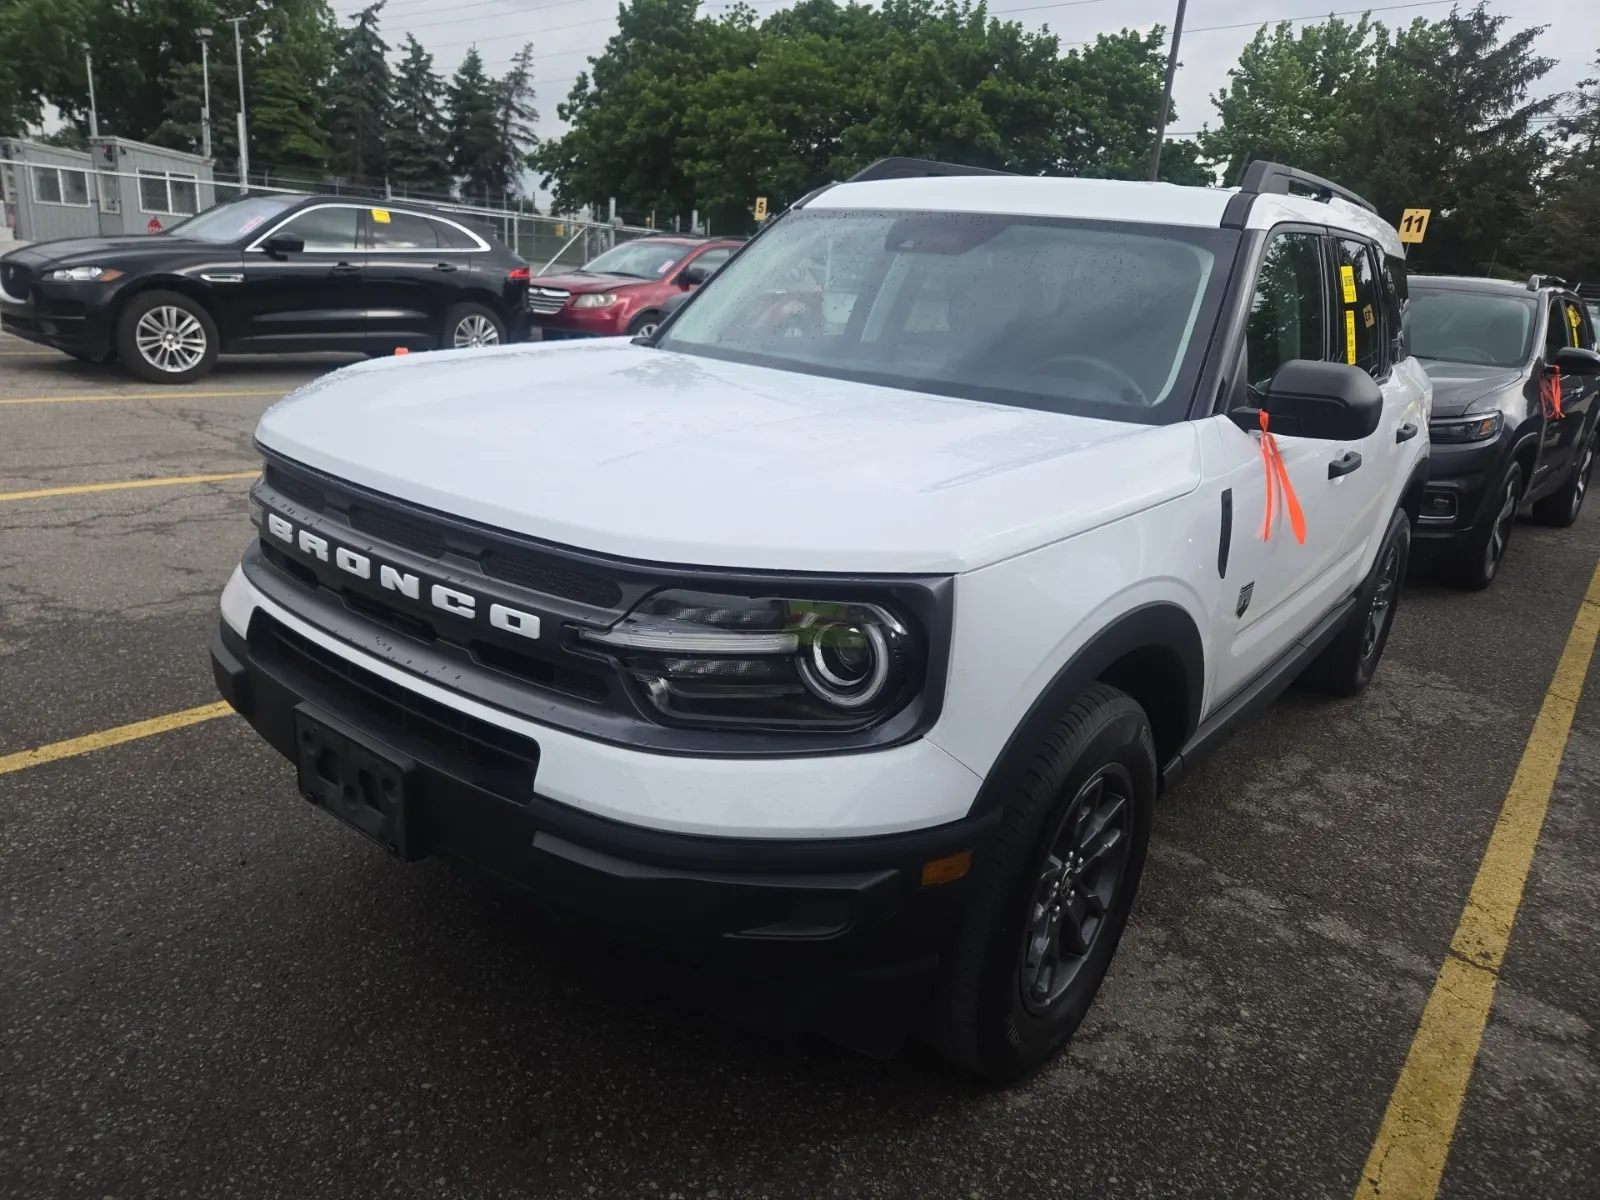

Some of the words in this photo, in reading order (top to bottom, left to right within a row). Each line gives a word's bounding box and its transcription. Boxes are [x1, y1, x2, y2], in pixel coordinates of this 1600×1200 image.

[758, 202, 764, 213] 5
[1403, 215, 1425, 233] 11
[268, 512, 541, 641] BRONCO
